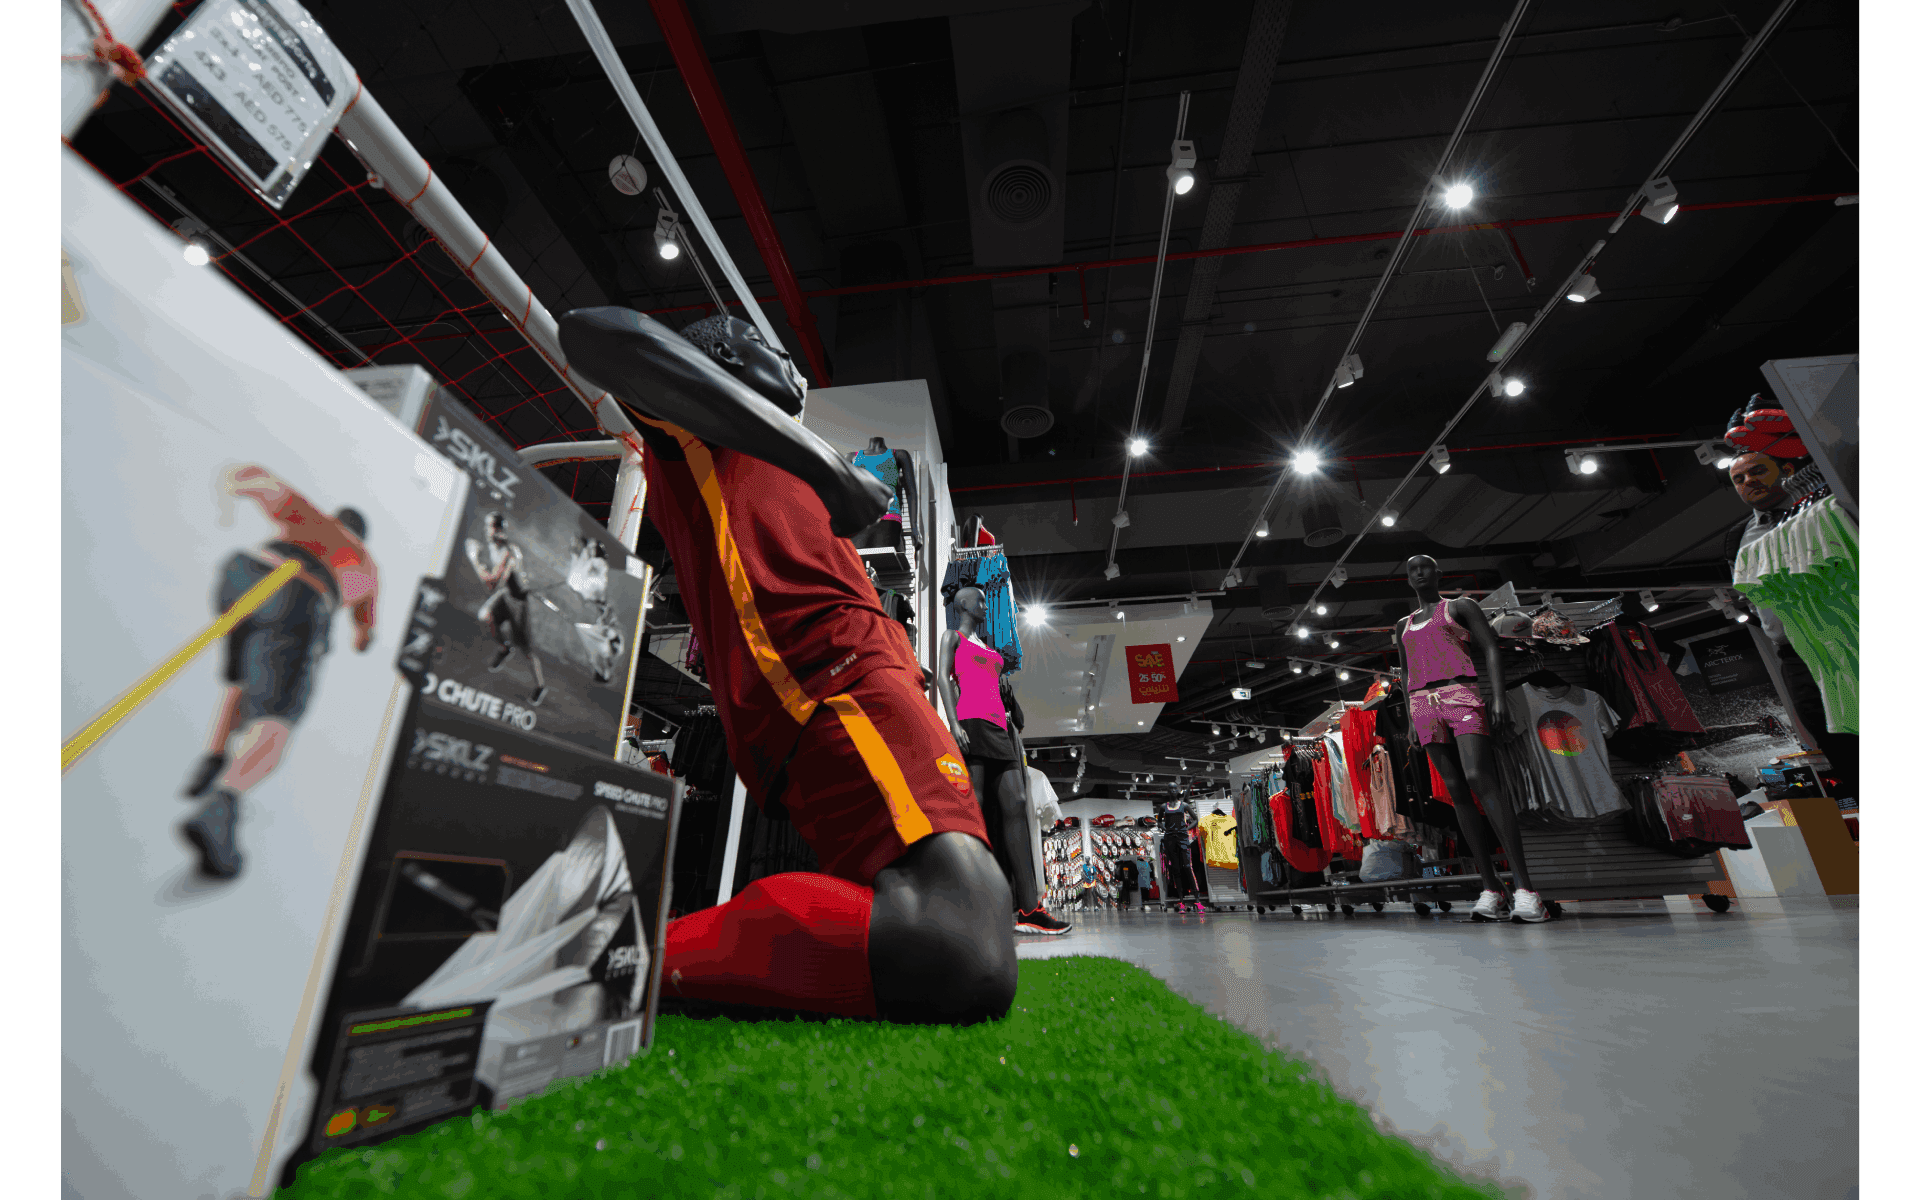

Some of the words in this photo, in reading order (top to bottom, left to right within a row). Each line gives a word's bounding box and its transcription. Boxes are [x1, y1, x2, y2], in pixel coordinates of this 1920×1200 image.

[234, 89, 268, 124] AED
[266, 123, 295, 153] 575
[252, 71, 285, 107] AED
[283, 105, 310, 134] 775
[449, 428, 520, 499] SKLZ
[437, 679, 503, 720] CHUTE
[503, 702, 537, 731] PRO
[426, 733, 495, 773] SKLZ
[624, 787, 651, 808] CHUTE
